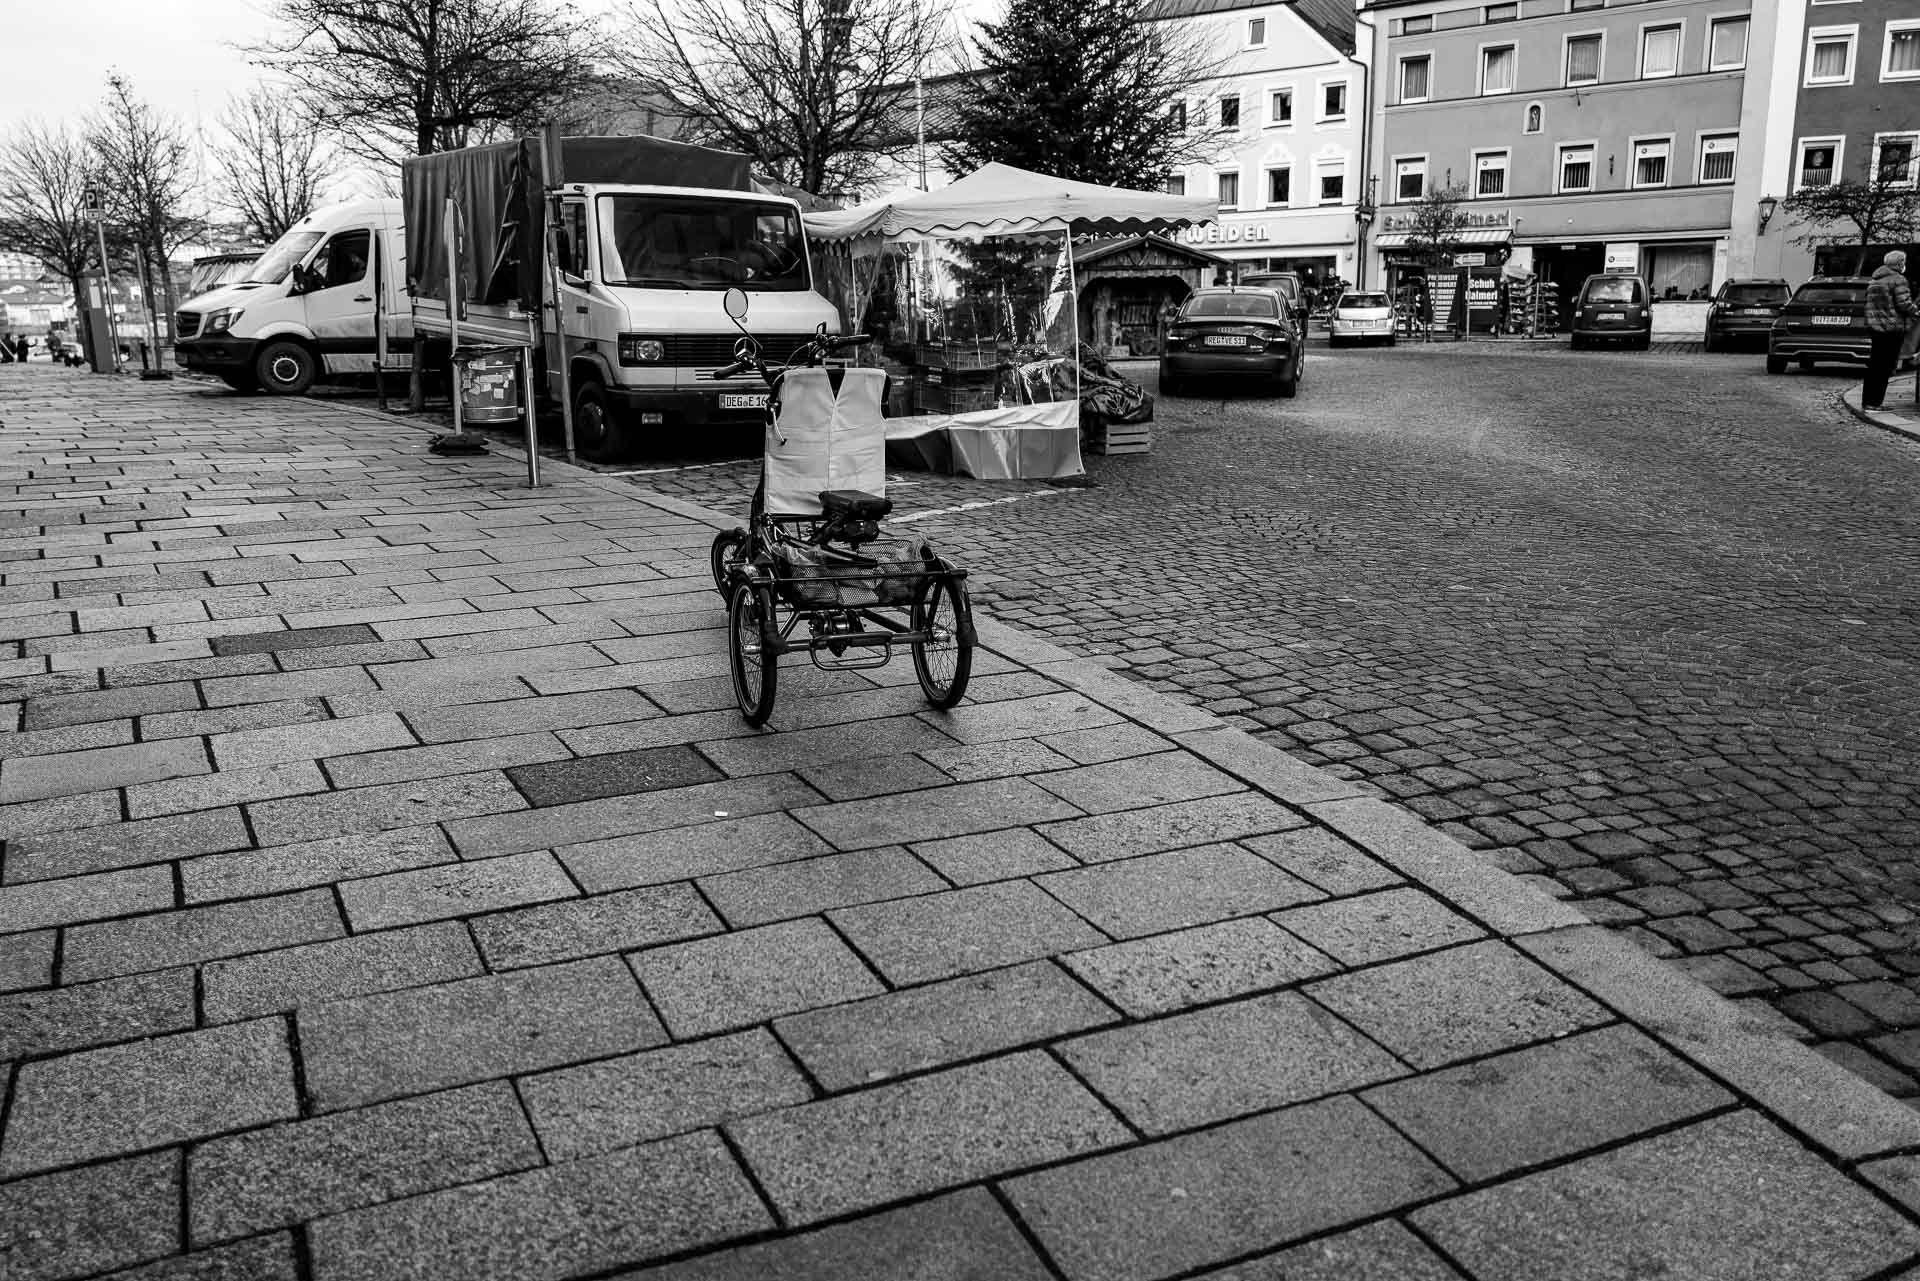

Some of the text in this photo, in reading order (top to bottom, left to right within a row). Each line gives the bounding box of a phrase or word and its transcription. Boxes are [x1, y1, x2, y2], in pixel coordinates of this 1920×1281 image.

[87, 192, 96, 208] P
[1469, 279, 1495, 289] Schuh
[726, 396, 743, 407] DEG
